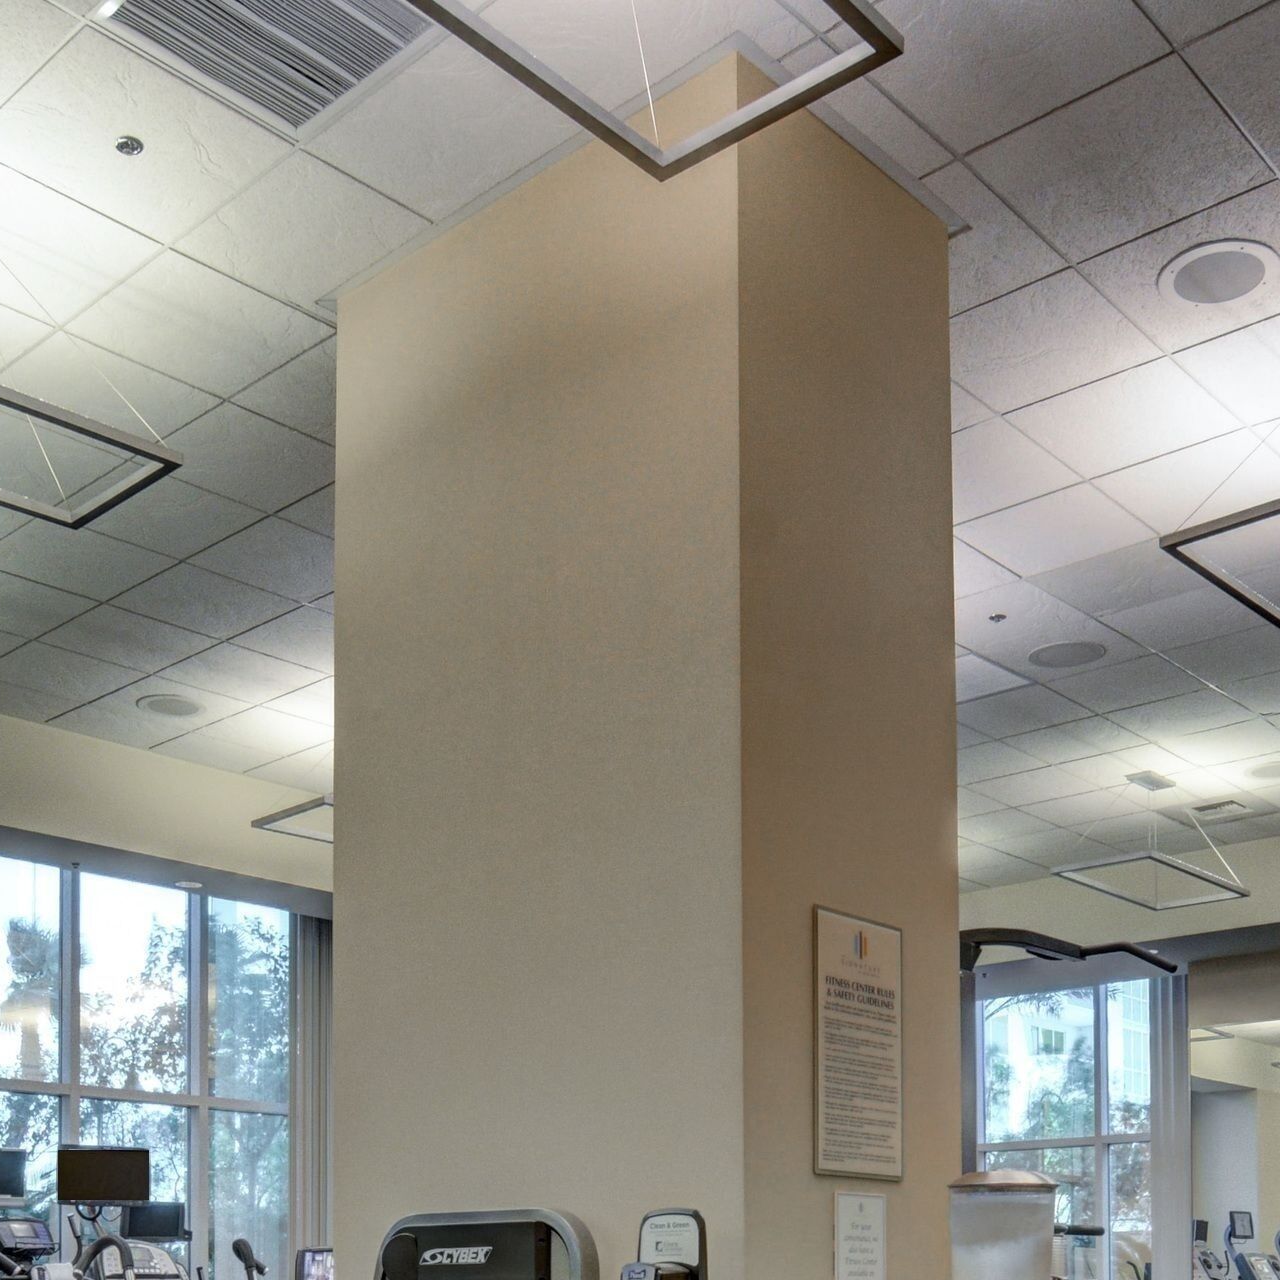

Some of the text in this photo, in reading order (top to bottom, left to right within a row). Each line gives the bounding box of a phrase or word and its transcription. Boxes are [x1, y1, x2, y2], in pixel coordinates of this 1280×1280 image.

[825, 975, 895, 999] FITNESS CENTER RULES
[826, 987, 895, 1010] & SAFETY GUIDELINES
[442, 1248, 488, 1264] CYBEX
